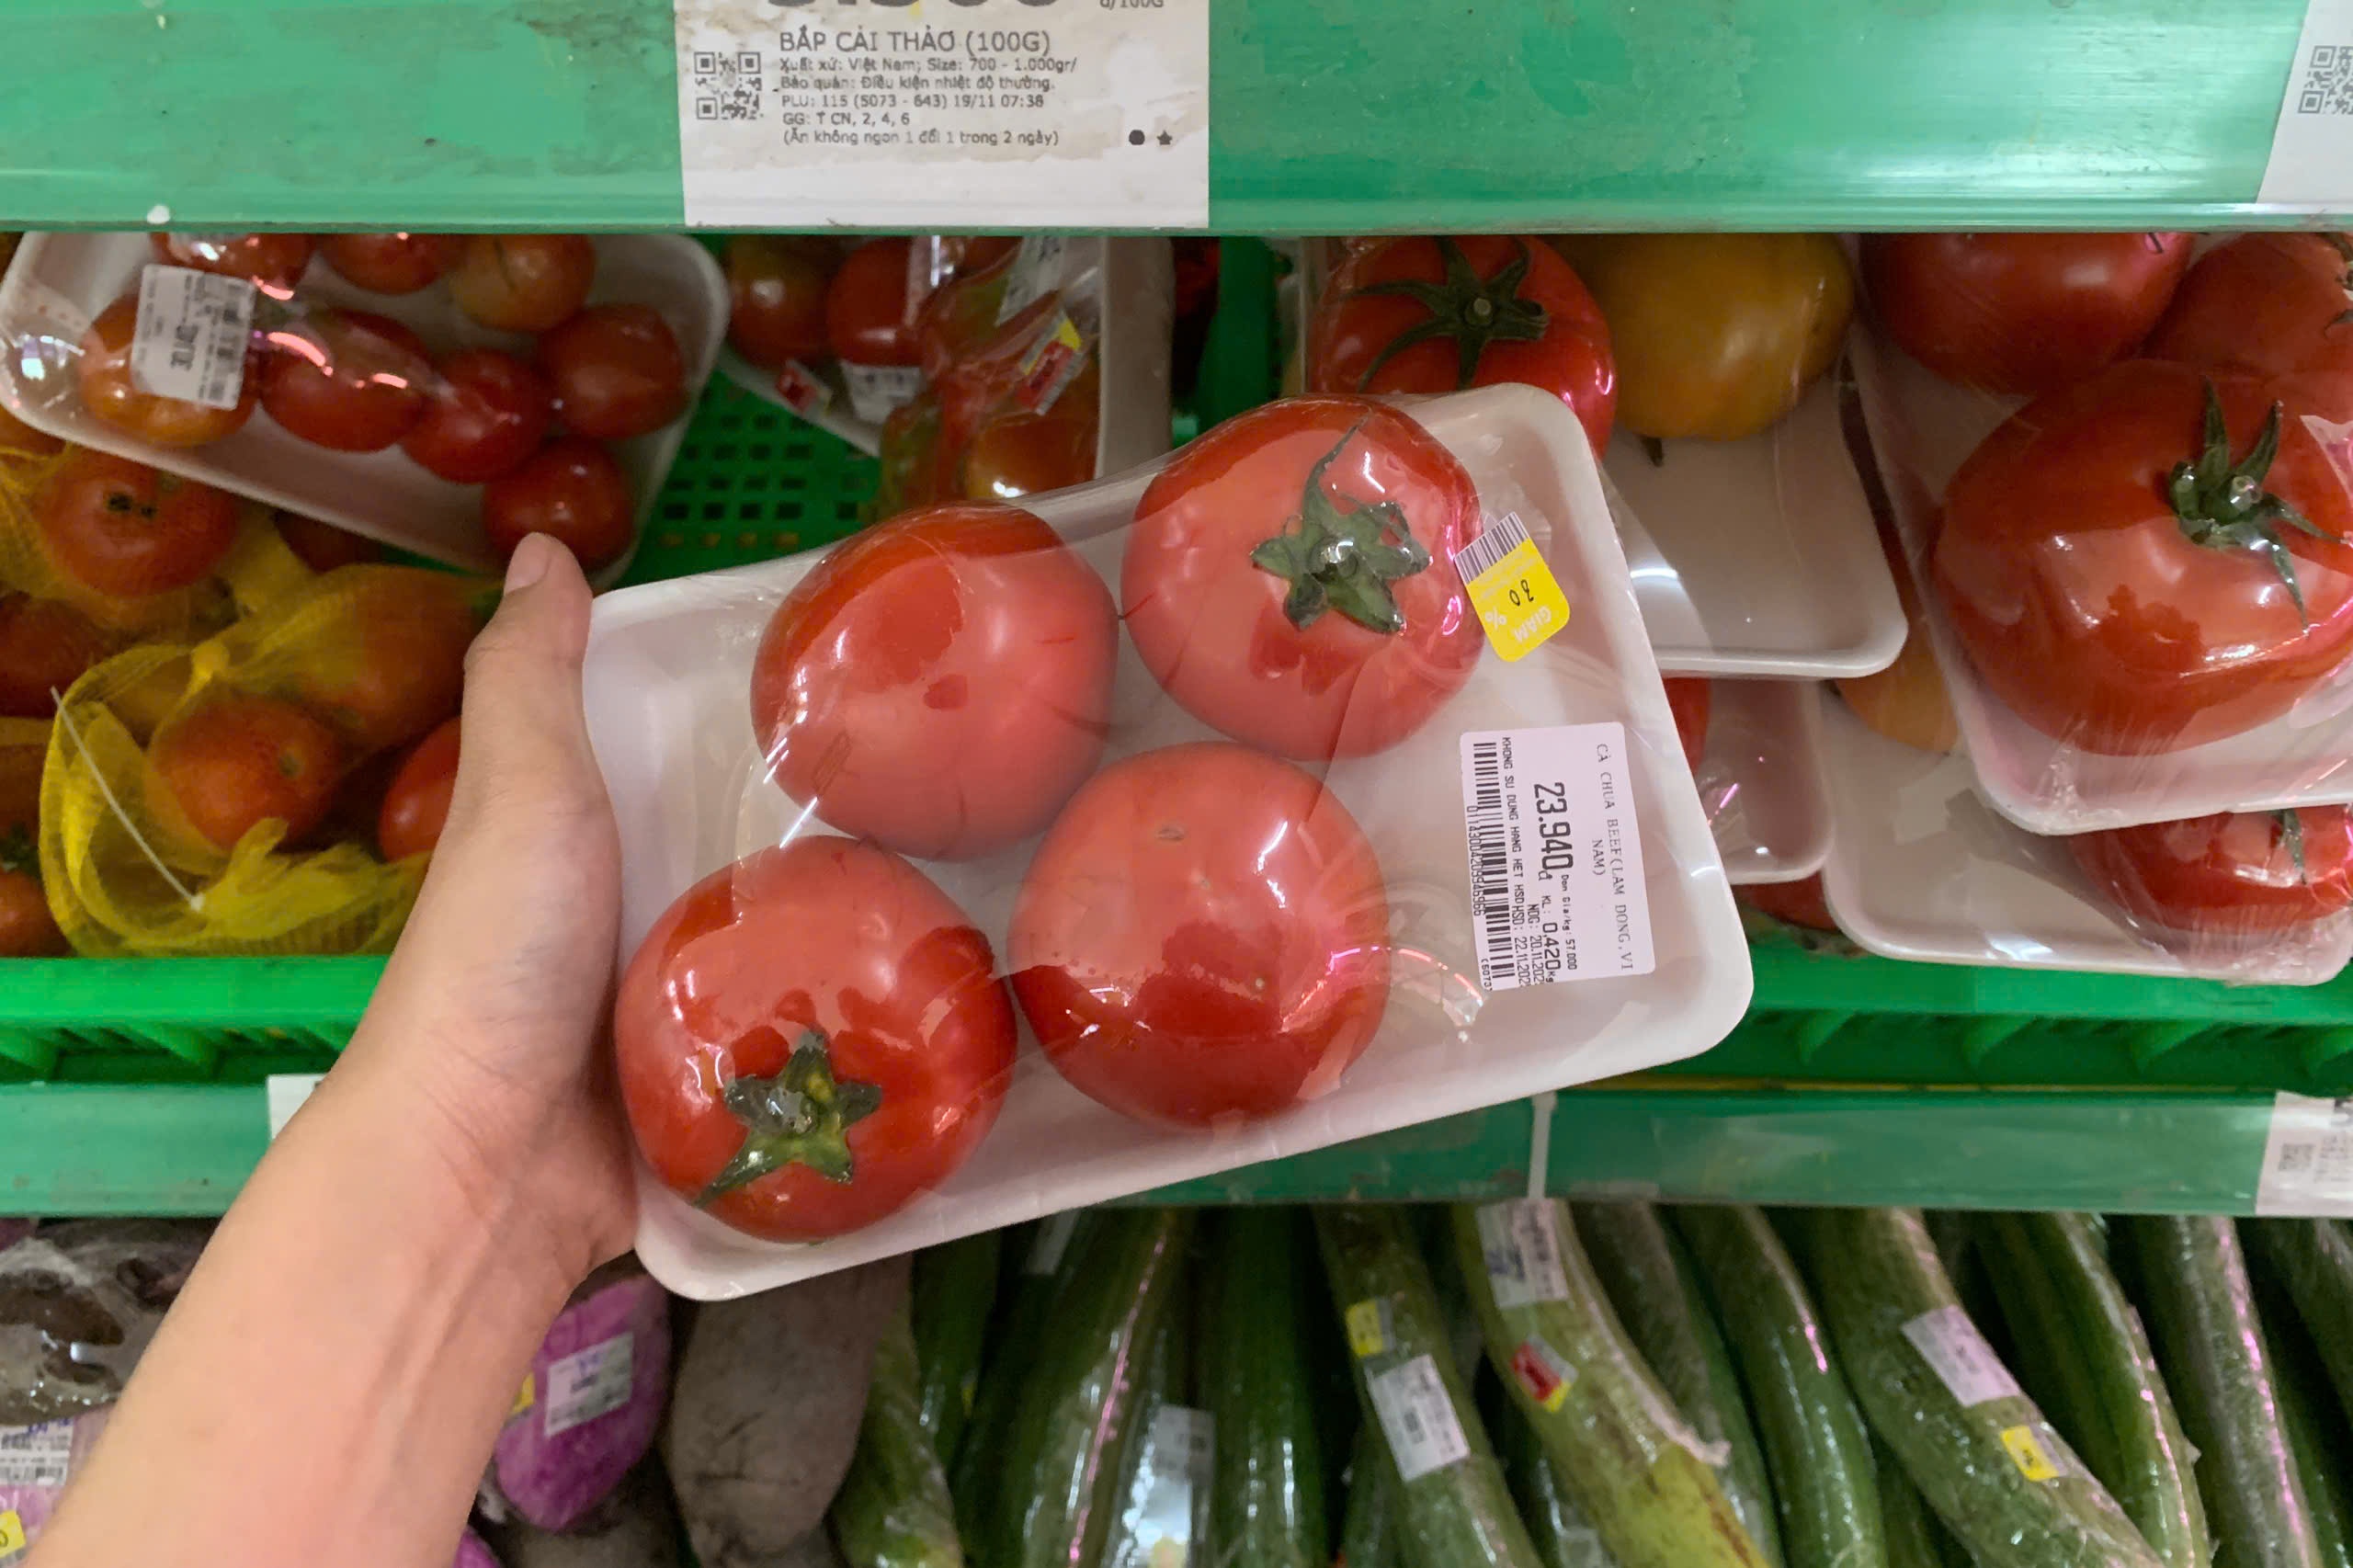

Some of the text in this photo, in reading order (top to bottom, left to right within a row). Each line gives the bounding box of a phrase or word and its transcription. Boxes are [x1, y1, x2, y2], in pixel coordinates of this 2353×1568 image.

[836, 24, 879, 51] CẢI
[966, 30, 1051, 56] (100G)
[848, 57, 877, 73] Việt
[927, 58, 963, 71] Size:
[969, 58, 996, 71] 700
[1014, 57, 1078, 74] 1.000gr/
[899, 74, 929, 90] kiện
[935, 74, 972, 91] nhiệt
[976, 75, 995, 91] độ
[781, 95, 815, 108] PLU:
[823, 95, 847, 108] 115
[854, 94, 897, 108] (5073
[914, 94, 947, 108] 643)
[954, 94, 995, 108] 19/11
[1000, 94, 1044, 108] 07:38
[783, 112, 810, 125] GG:
[831, 112, 857, 127] CN,
[862, 112, 876, 127] 2,
[881, 112, 895, 127] 4,
[901, 112, 910, 125] 6
[813, 129, 858, 145] không
[864, 131, 899, 145] ngon
[947, 131, 954, 143] 1
[960, 131, 998, 146] trong
[1003, 131, 1012, 143] 2
[1600, 772, 1615, 809] CHUA
[1502, 737, 1524, 903] KHONG SU DUNG HANG HET HSD
[1592, 839, 1606, 876] NAM)
[1541, 895, 1552, 914] KL:
[1561, 875, 1569, 892] Don
[1565, 939, 1577, 971] 57.000
[1511, 905, 1530, 987] HSD: 22.11.202
[1529, 936, 1544, 985] 20.11.202
